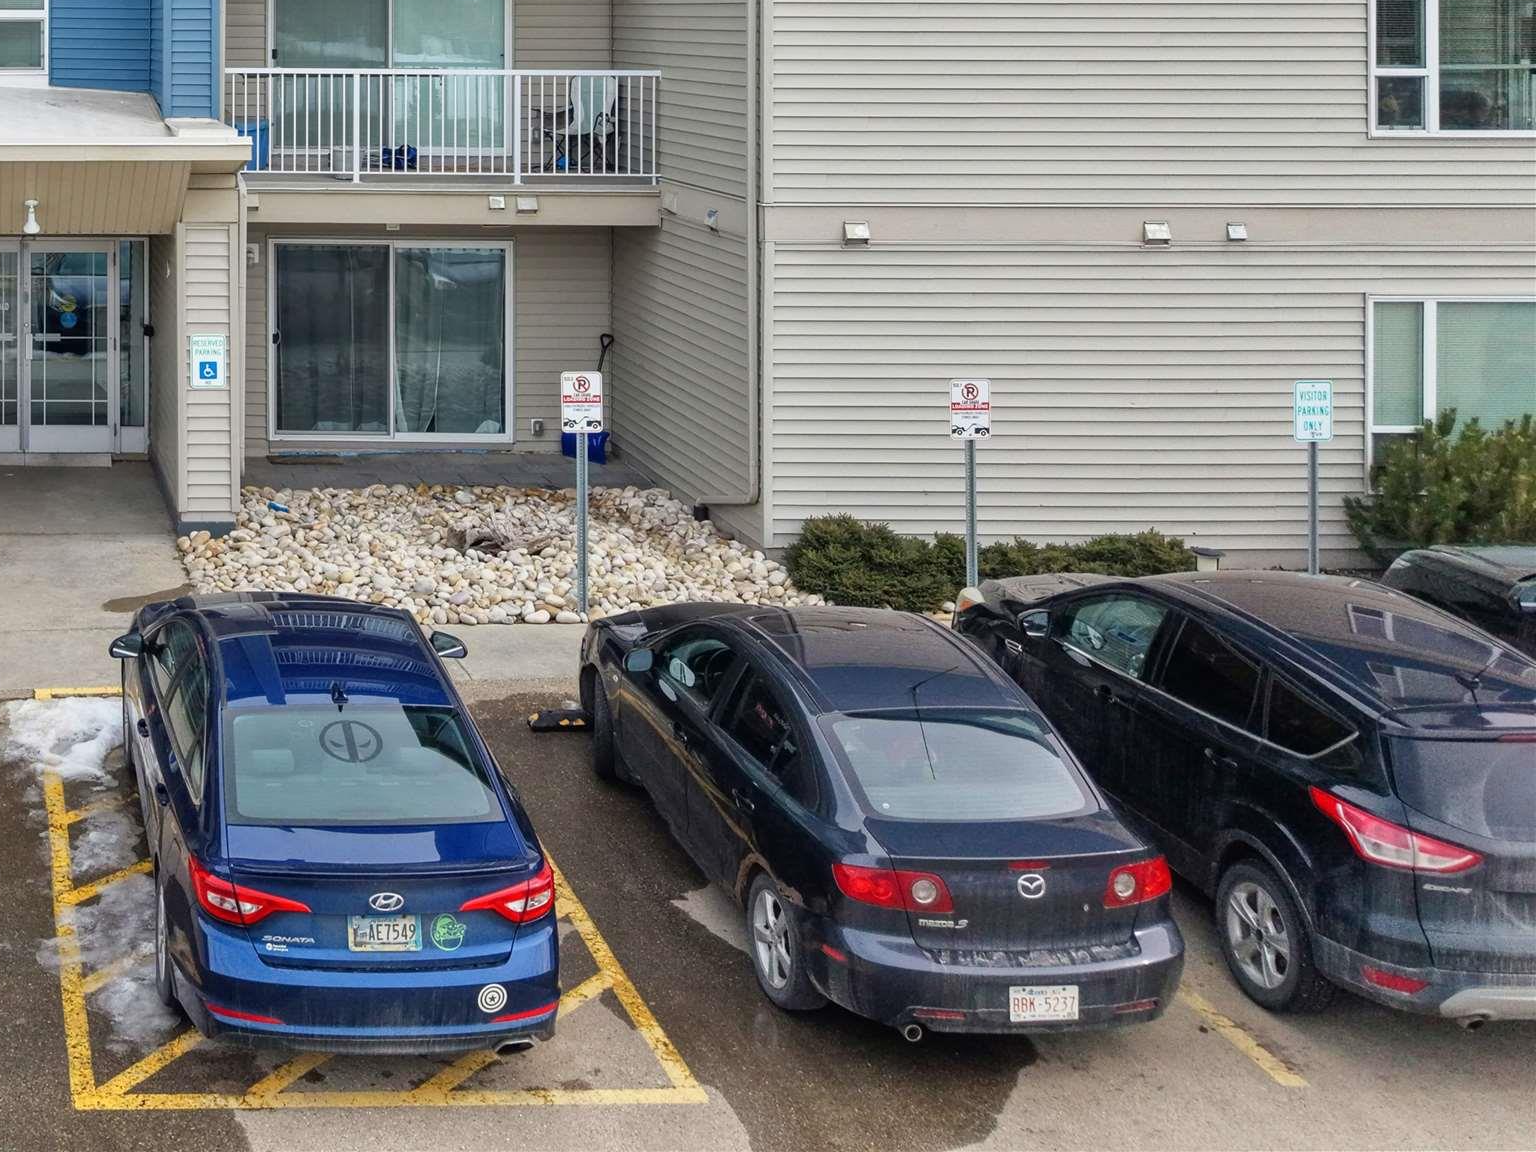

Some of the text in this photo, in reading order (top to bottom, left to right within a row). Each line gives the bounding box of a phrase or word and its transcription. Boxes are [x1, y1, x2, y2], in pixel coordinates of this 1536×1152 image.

[193, 339, 224, 347] RESERVED
[195, 348, 222, 356] PARKING
[1299, 391, 1327, 401] VISITOR
[1298, 406, 1329, 416] PARKING
[1304, 421, 1322, 431] ONLY
[369, 923, 416, 941] AE7549
[262, 935, 315, 944] SONATA
